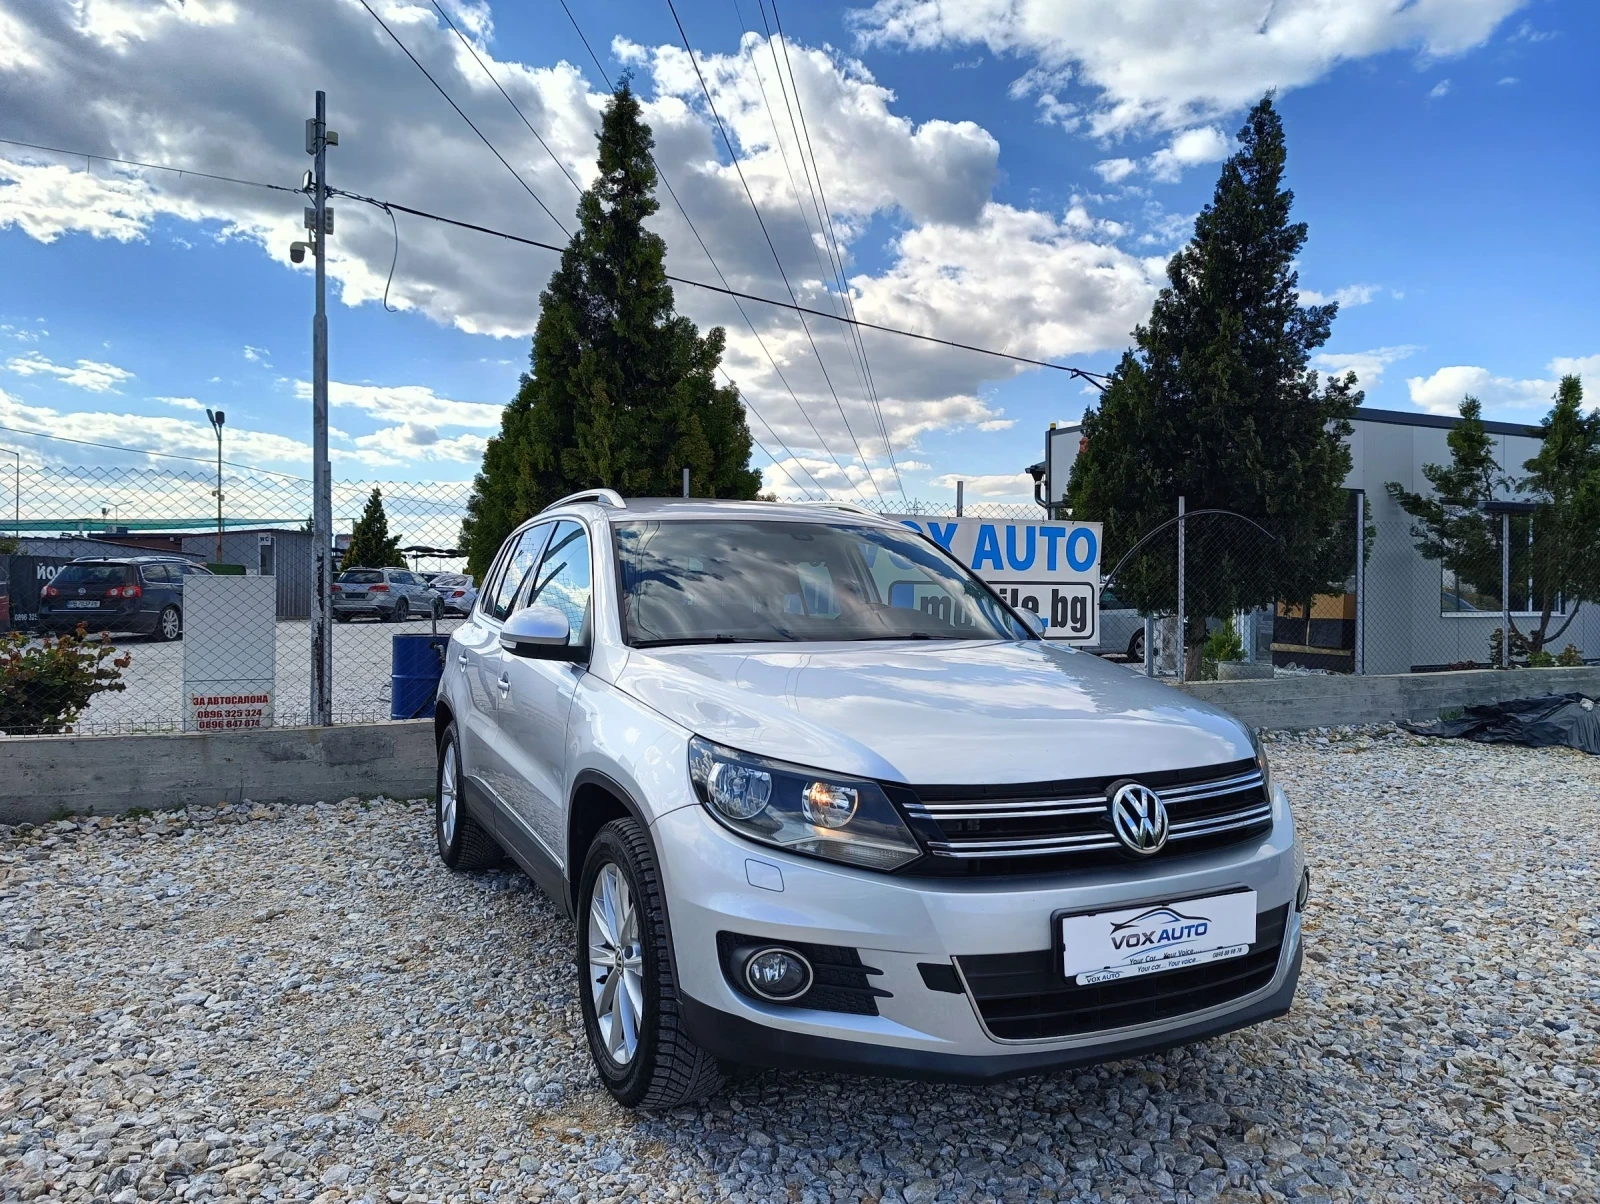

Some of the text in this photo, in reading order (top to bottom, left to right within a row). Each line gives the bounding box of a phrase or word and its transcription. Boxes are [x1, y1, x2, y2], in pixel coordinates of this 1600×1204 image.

[971, 523, 1098, 572] AUTO
[193, 694, 269, 706] ЗА АВТОСАЛОНА
[197, 709, 262, 719] 0896 325 324
[199, 719, 260, 729] 0896 847 874
[1111, 922, 1208, 950] VOX AUTO
[1138, 965, 1150, 973] Your
[1086, 972, 1121, 983] VOX AUTO
